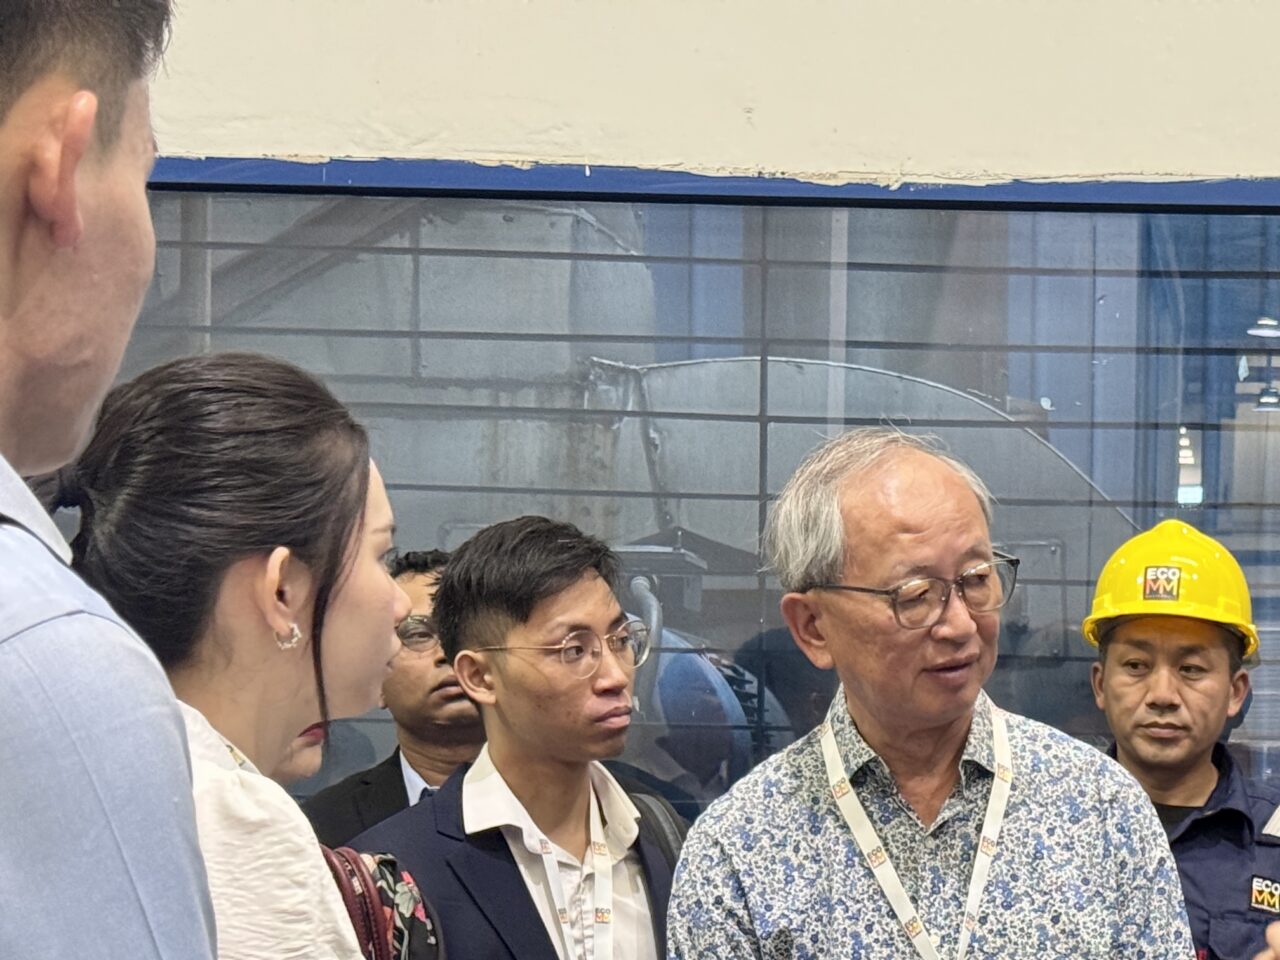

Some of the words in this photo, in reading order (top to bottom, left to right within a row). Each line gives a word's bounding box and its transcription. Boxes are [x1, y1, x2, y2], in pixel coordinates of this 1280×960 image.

[1147, 568, 1180, 580] ECO
[1146, 579, 1179, 596] MM
[1252, 890, 1280, 910] MM
